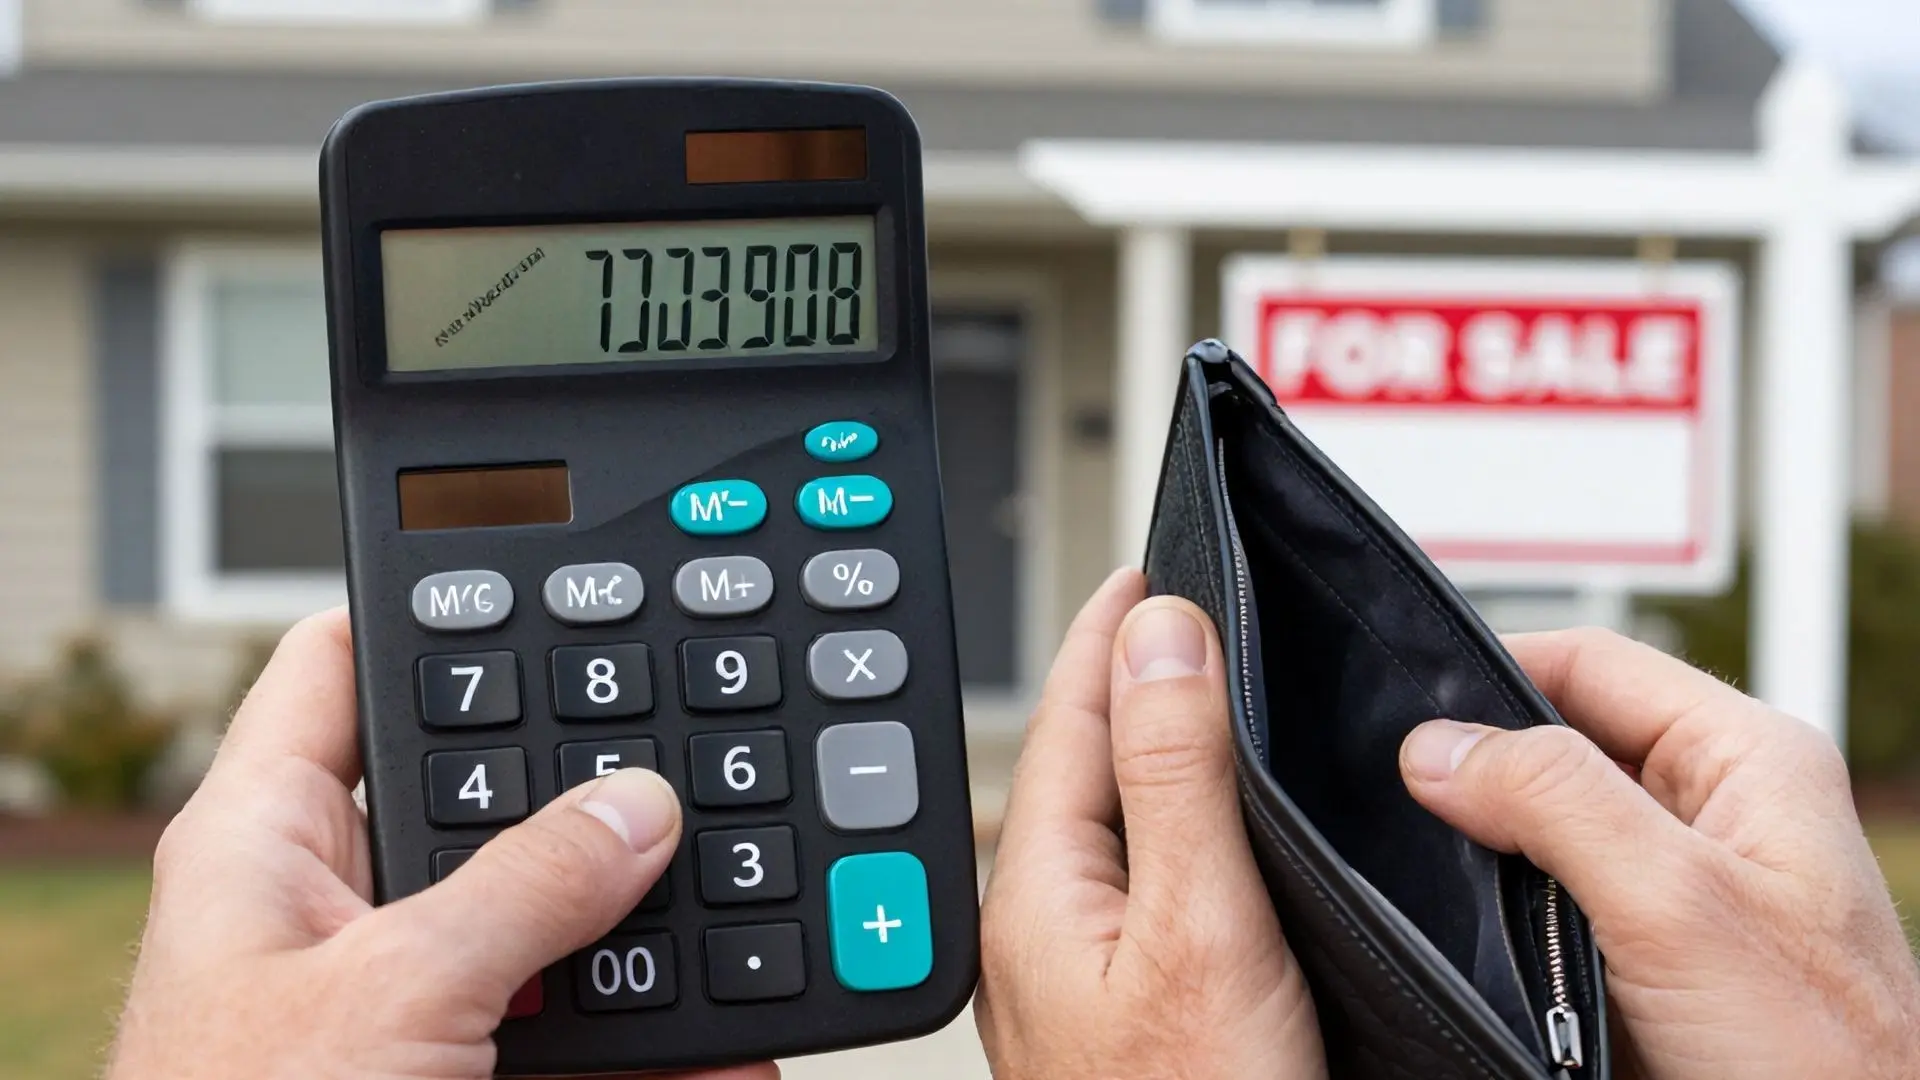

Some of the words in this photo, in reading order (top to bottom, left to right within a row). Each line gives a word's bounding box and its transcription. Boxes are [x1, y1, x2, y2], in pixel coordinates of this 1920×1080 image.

[1271, 309, 1451, 398] FOR
[1458, 309, 1690, 398] SALE
[833, 562, 874, 596] %
[450, 665, 484, 712] 7
[586, 657, 620, 704] 8
[715, 650, 749, 695] 9
[458, 763, 494, 810] 4
[723, 745, 757, 791] 6
[732, 842, 764, 888] 3
[592, 946, 656, 996] 00
